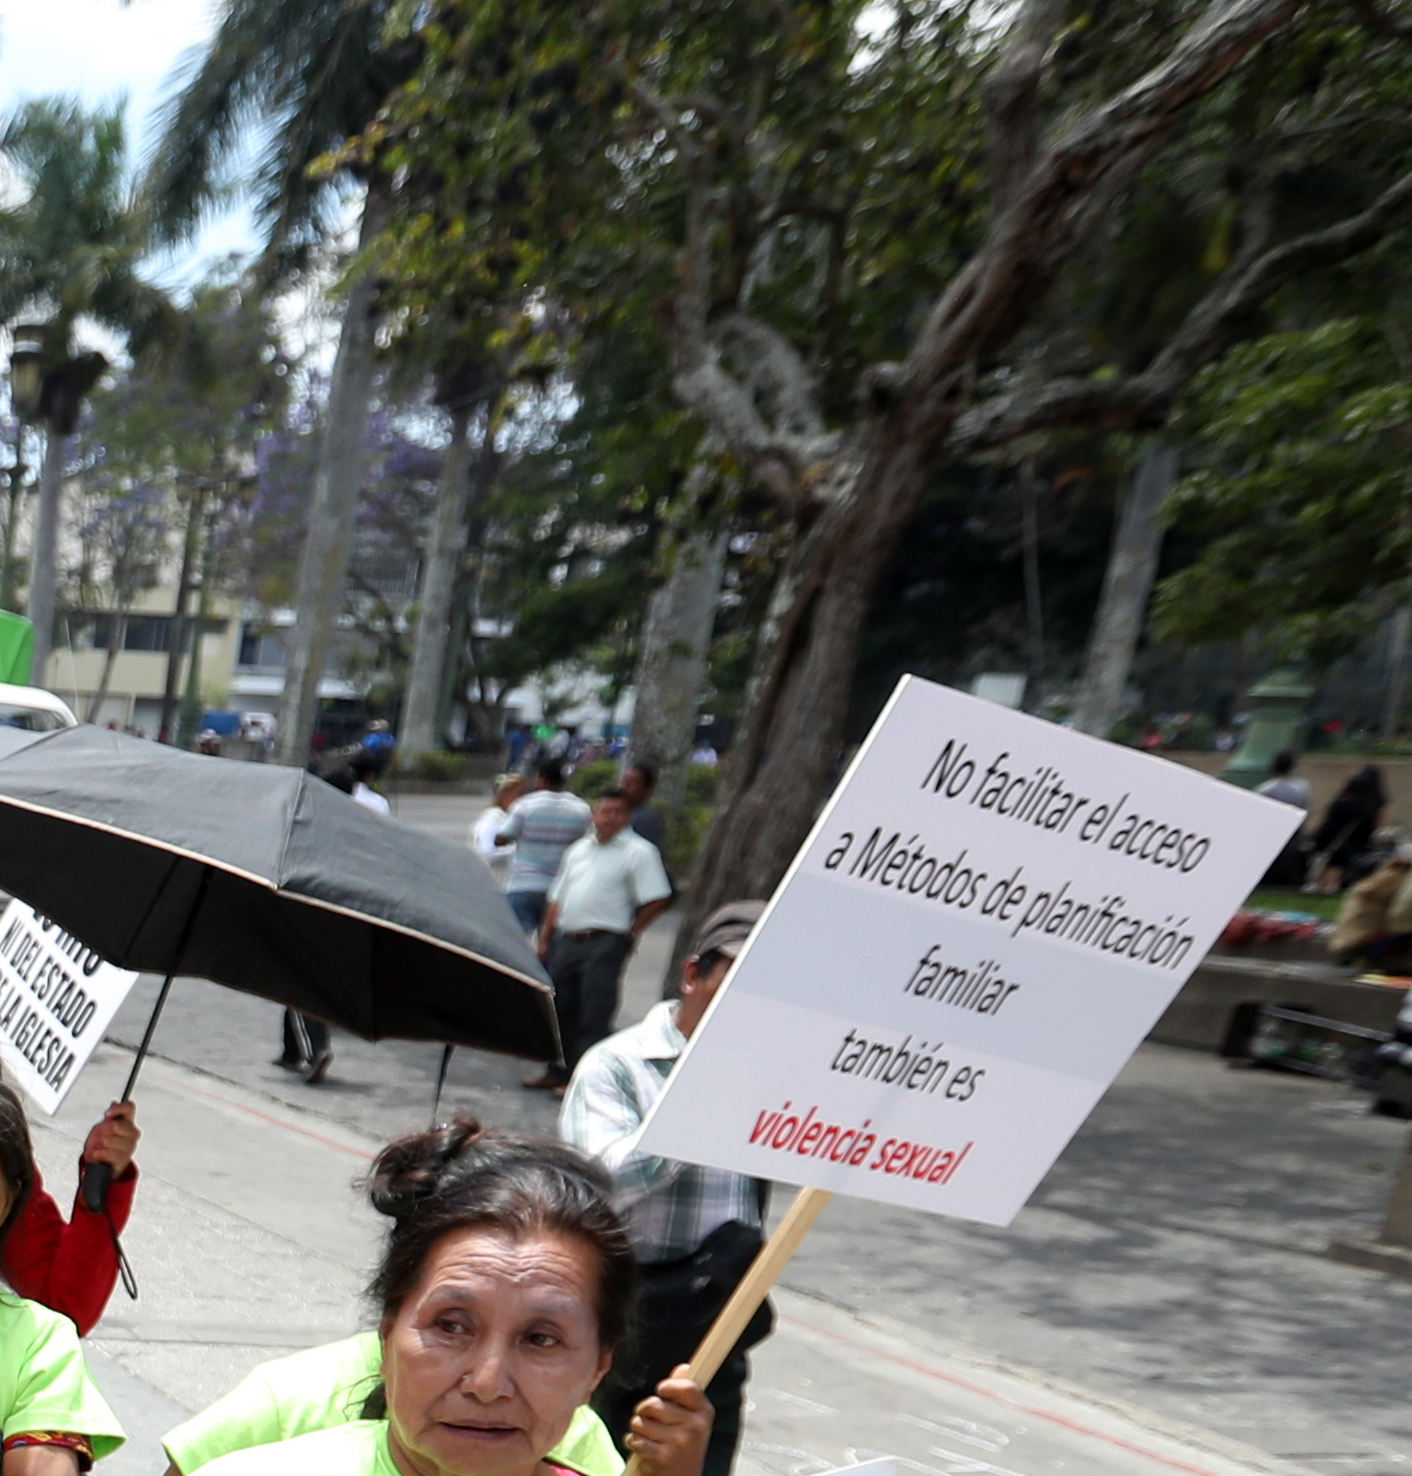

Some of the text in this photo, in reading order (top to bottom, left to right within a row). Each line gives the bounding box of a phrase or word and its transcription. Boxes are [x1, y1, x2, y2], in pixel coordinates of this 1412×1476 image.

[919, 739, 1211, 875] No facilitar el acceso
[825, 826, 1195, 972] a Métodos de planificación
[10, 935, 43, 982] DEL
[31, 956, 98, 1038] ESTADO
[903, 944, 1020, 1017] familiar
[9, 1003, 78, 1094] IGLESIA
[829, 1028, 985, 1102] también es
[749, 1101, 974, 1185] violencia sexual
